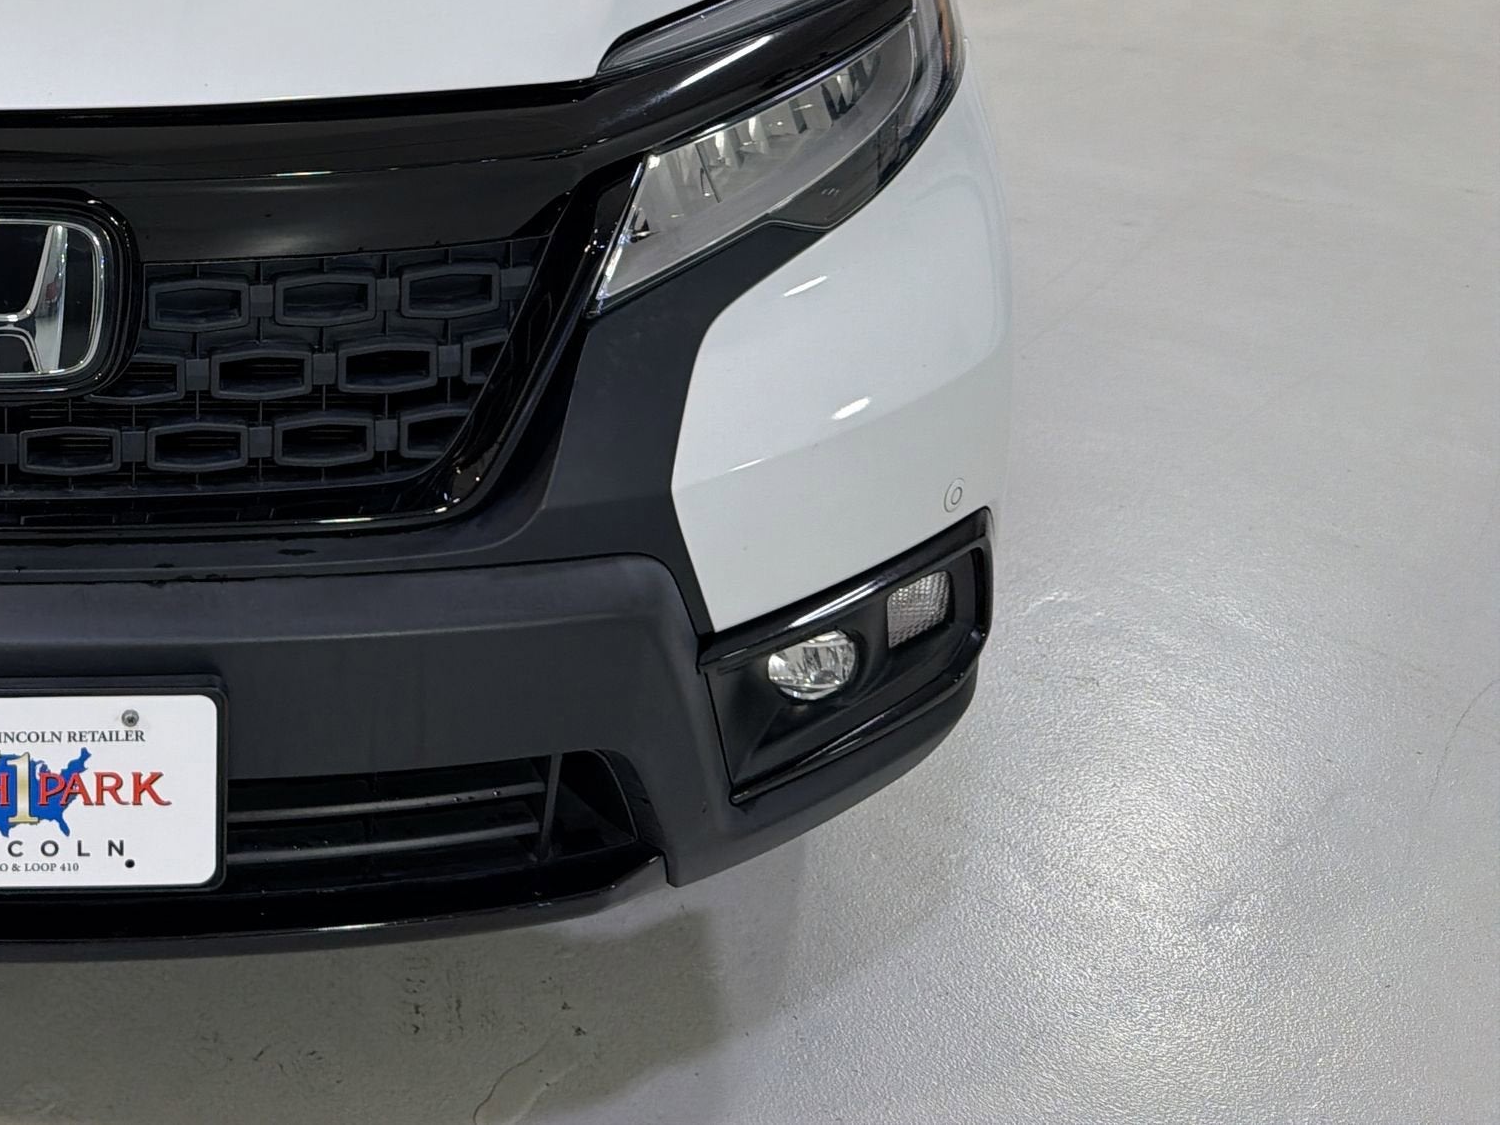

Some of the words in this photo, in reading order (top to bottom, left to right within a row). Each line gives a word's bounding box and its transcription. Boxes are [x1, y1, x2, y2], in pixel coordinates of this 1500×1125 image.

[67, 731, 146, 743] RETAILER
[37, 772, 172, 806] PARK
[11, 863, 21, 872] &
[24, 862, 57, 873] LOOP
[60, 862, 79, 872] 410
